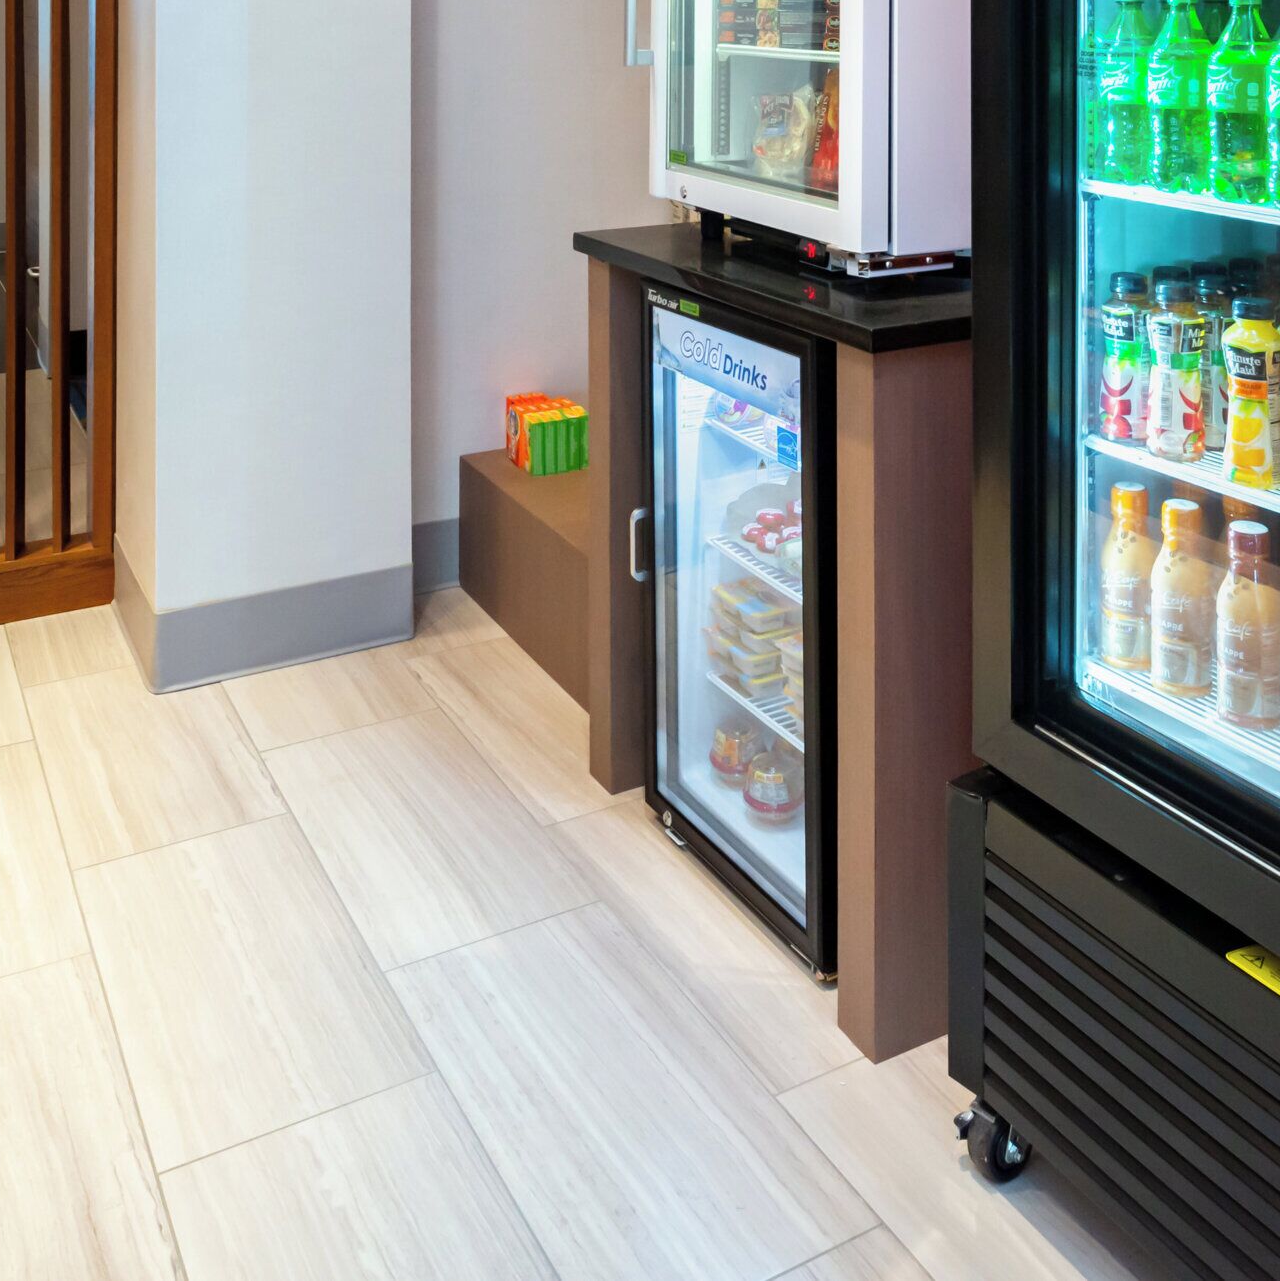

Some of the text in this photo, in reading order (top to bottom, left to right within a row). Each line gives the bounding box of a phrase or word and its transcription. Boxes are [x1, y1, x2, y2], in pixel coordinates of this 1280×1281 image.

[647, 287, 679, 311] Turbo air
[680, 330, 768, 392] Cold Drinks
